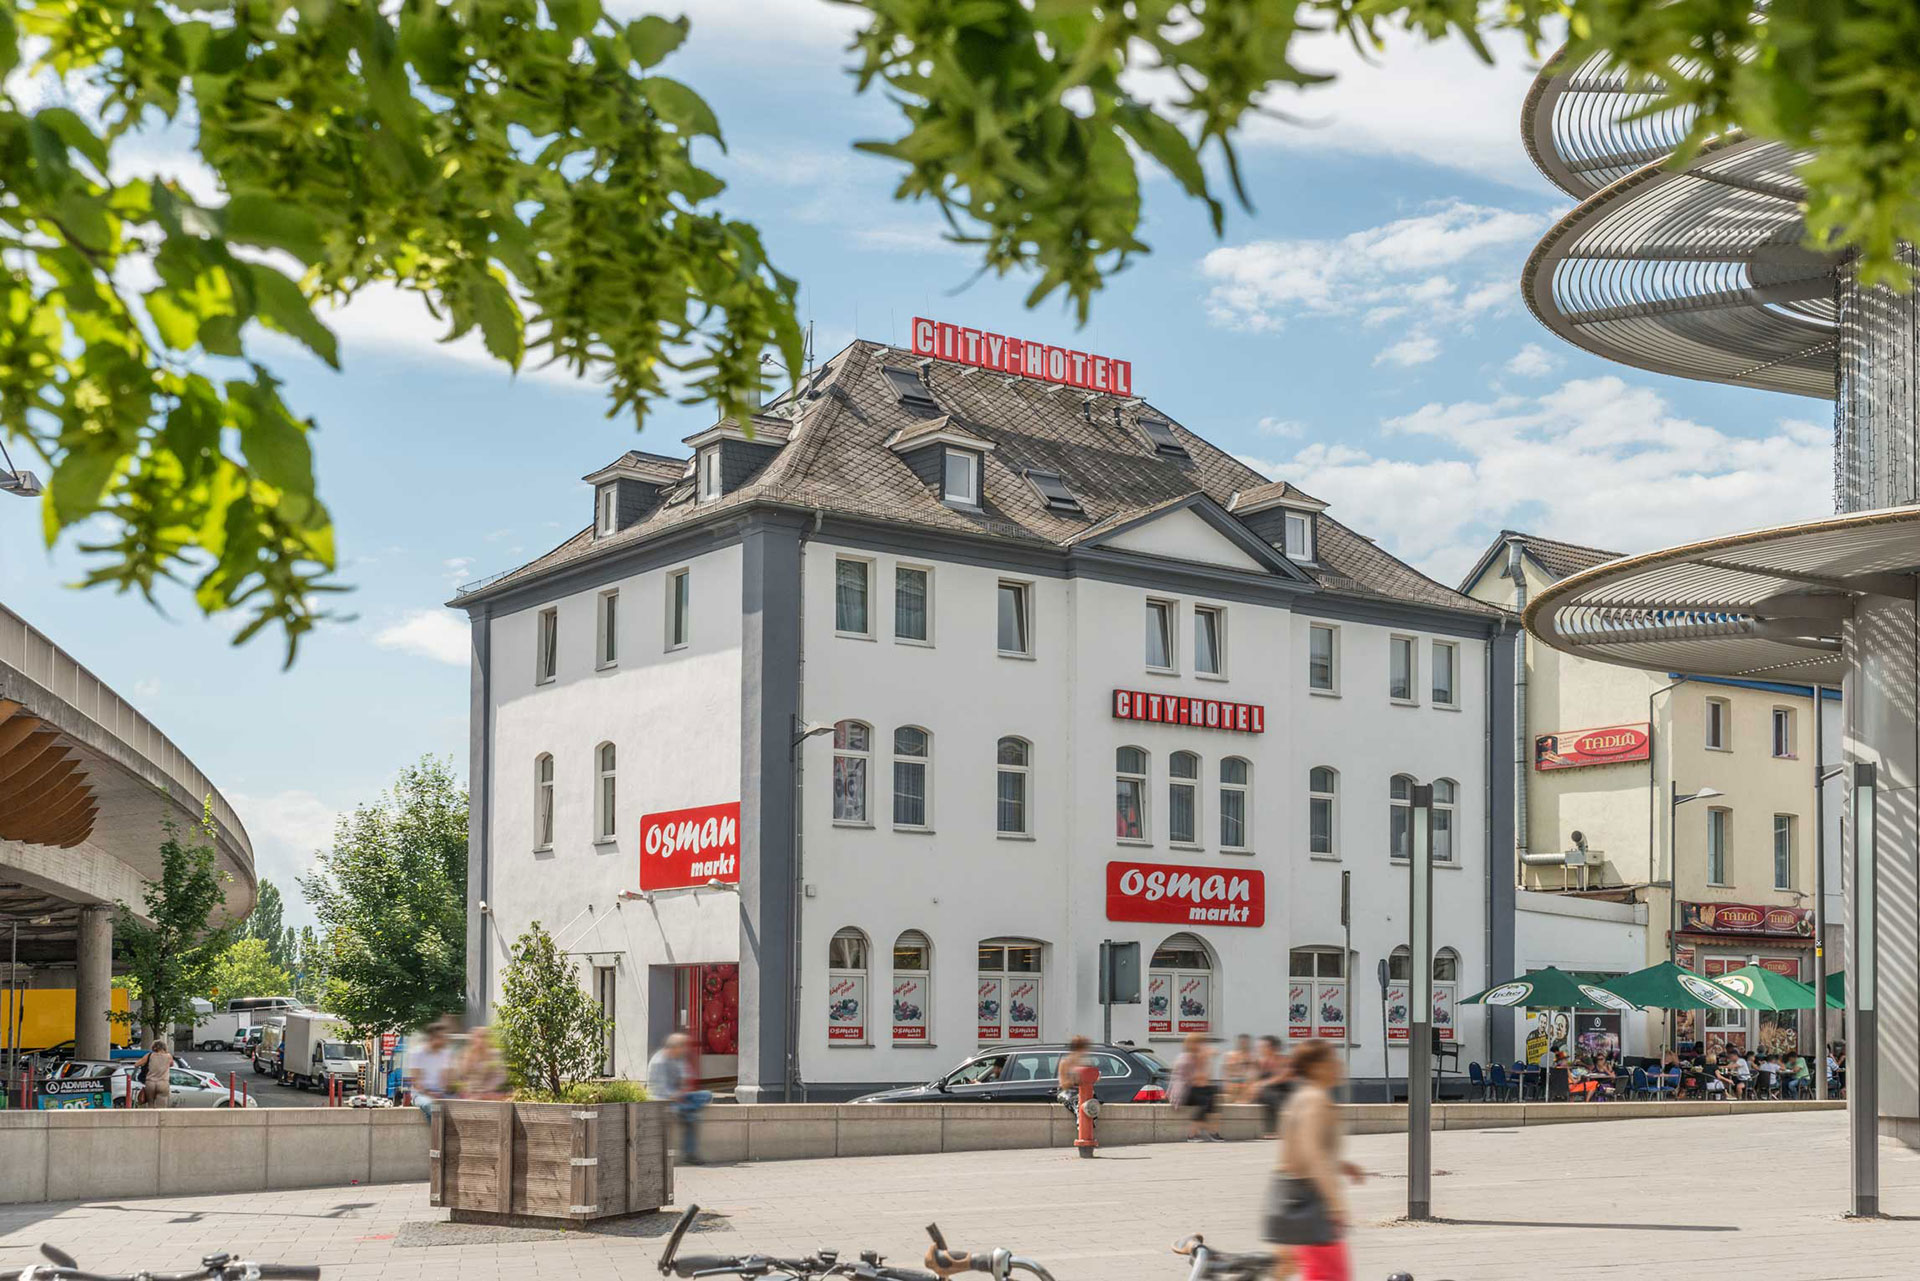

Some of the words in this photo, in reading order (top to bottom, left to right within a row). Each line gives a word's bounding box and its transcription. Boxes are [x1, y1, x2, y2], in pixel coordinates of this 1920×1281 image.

[917, 321, 1128, 393] CITY-HOTEL
[1117, 692, 1261, 730] CITY-HOTEL
[645, 816, 736, 858] Osman
[690, 853, 735, 877] markt
[1119, 868, 1250, 903] Osman
[1189, 904, 1249, 922] markt
[61, 1080, 104, 1089] ADMIRAL
